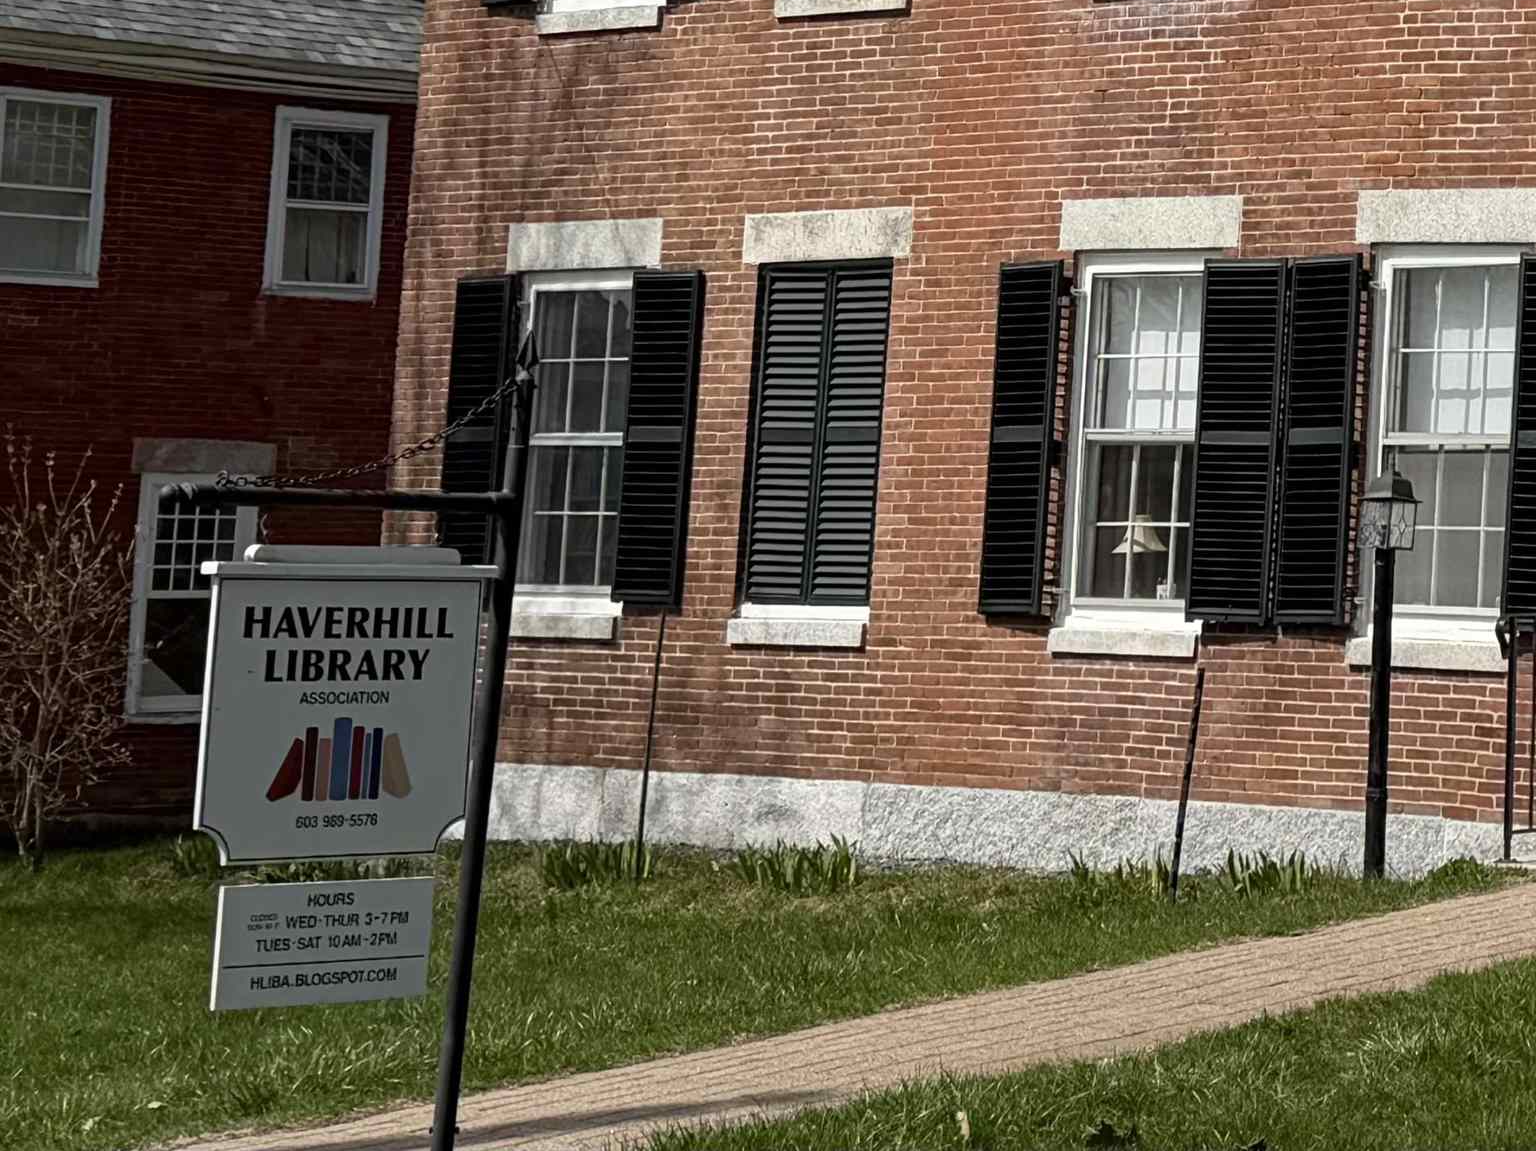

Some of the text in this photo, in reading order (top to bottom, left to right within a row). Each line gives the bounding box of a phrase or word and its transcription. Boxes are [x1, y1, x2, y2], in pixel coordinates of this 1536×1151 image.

[242, 606, 454, 639] HAVERHILL
[264, 649, 430, 682] LIBRARY
[299, 691, 390, 705] ASSOCIATION
[295, 815, 318, 829] 603
[307, 892, 355, 907] HOURS
